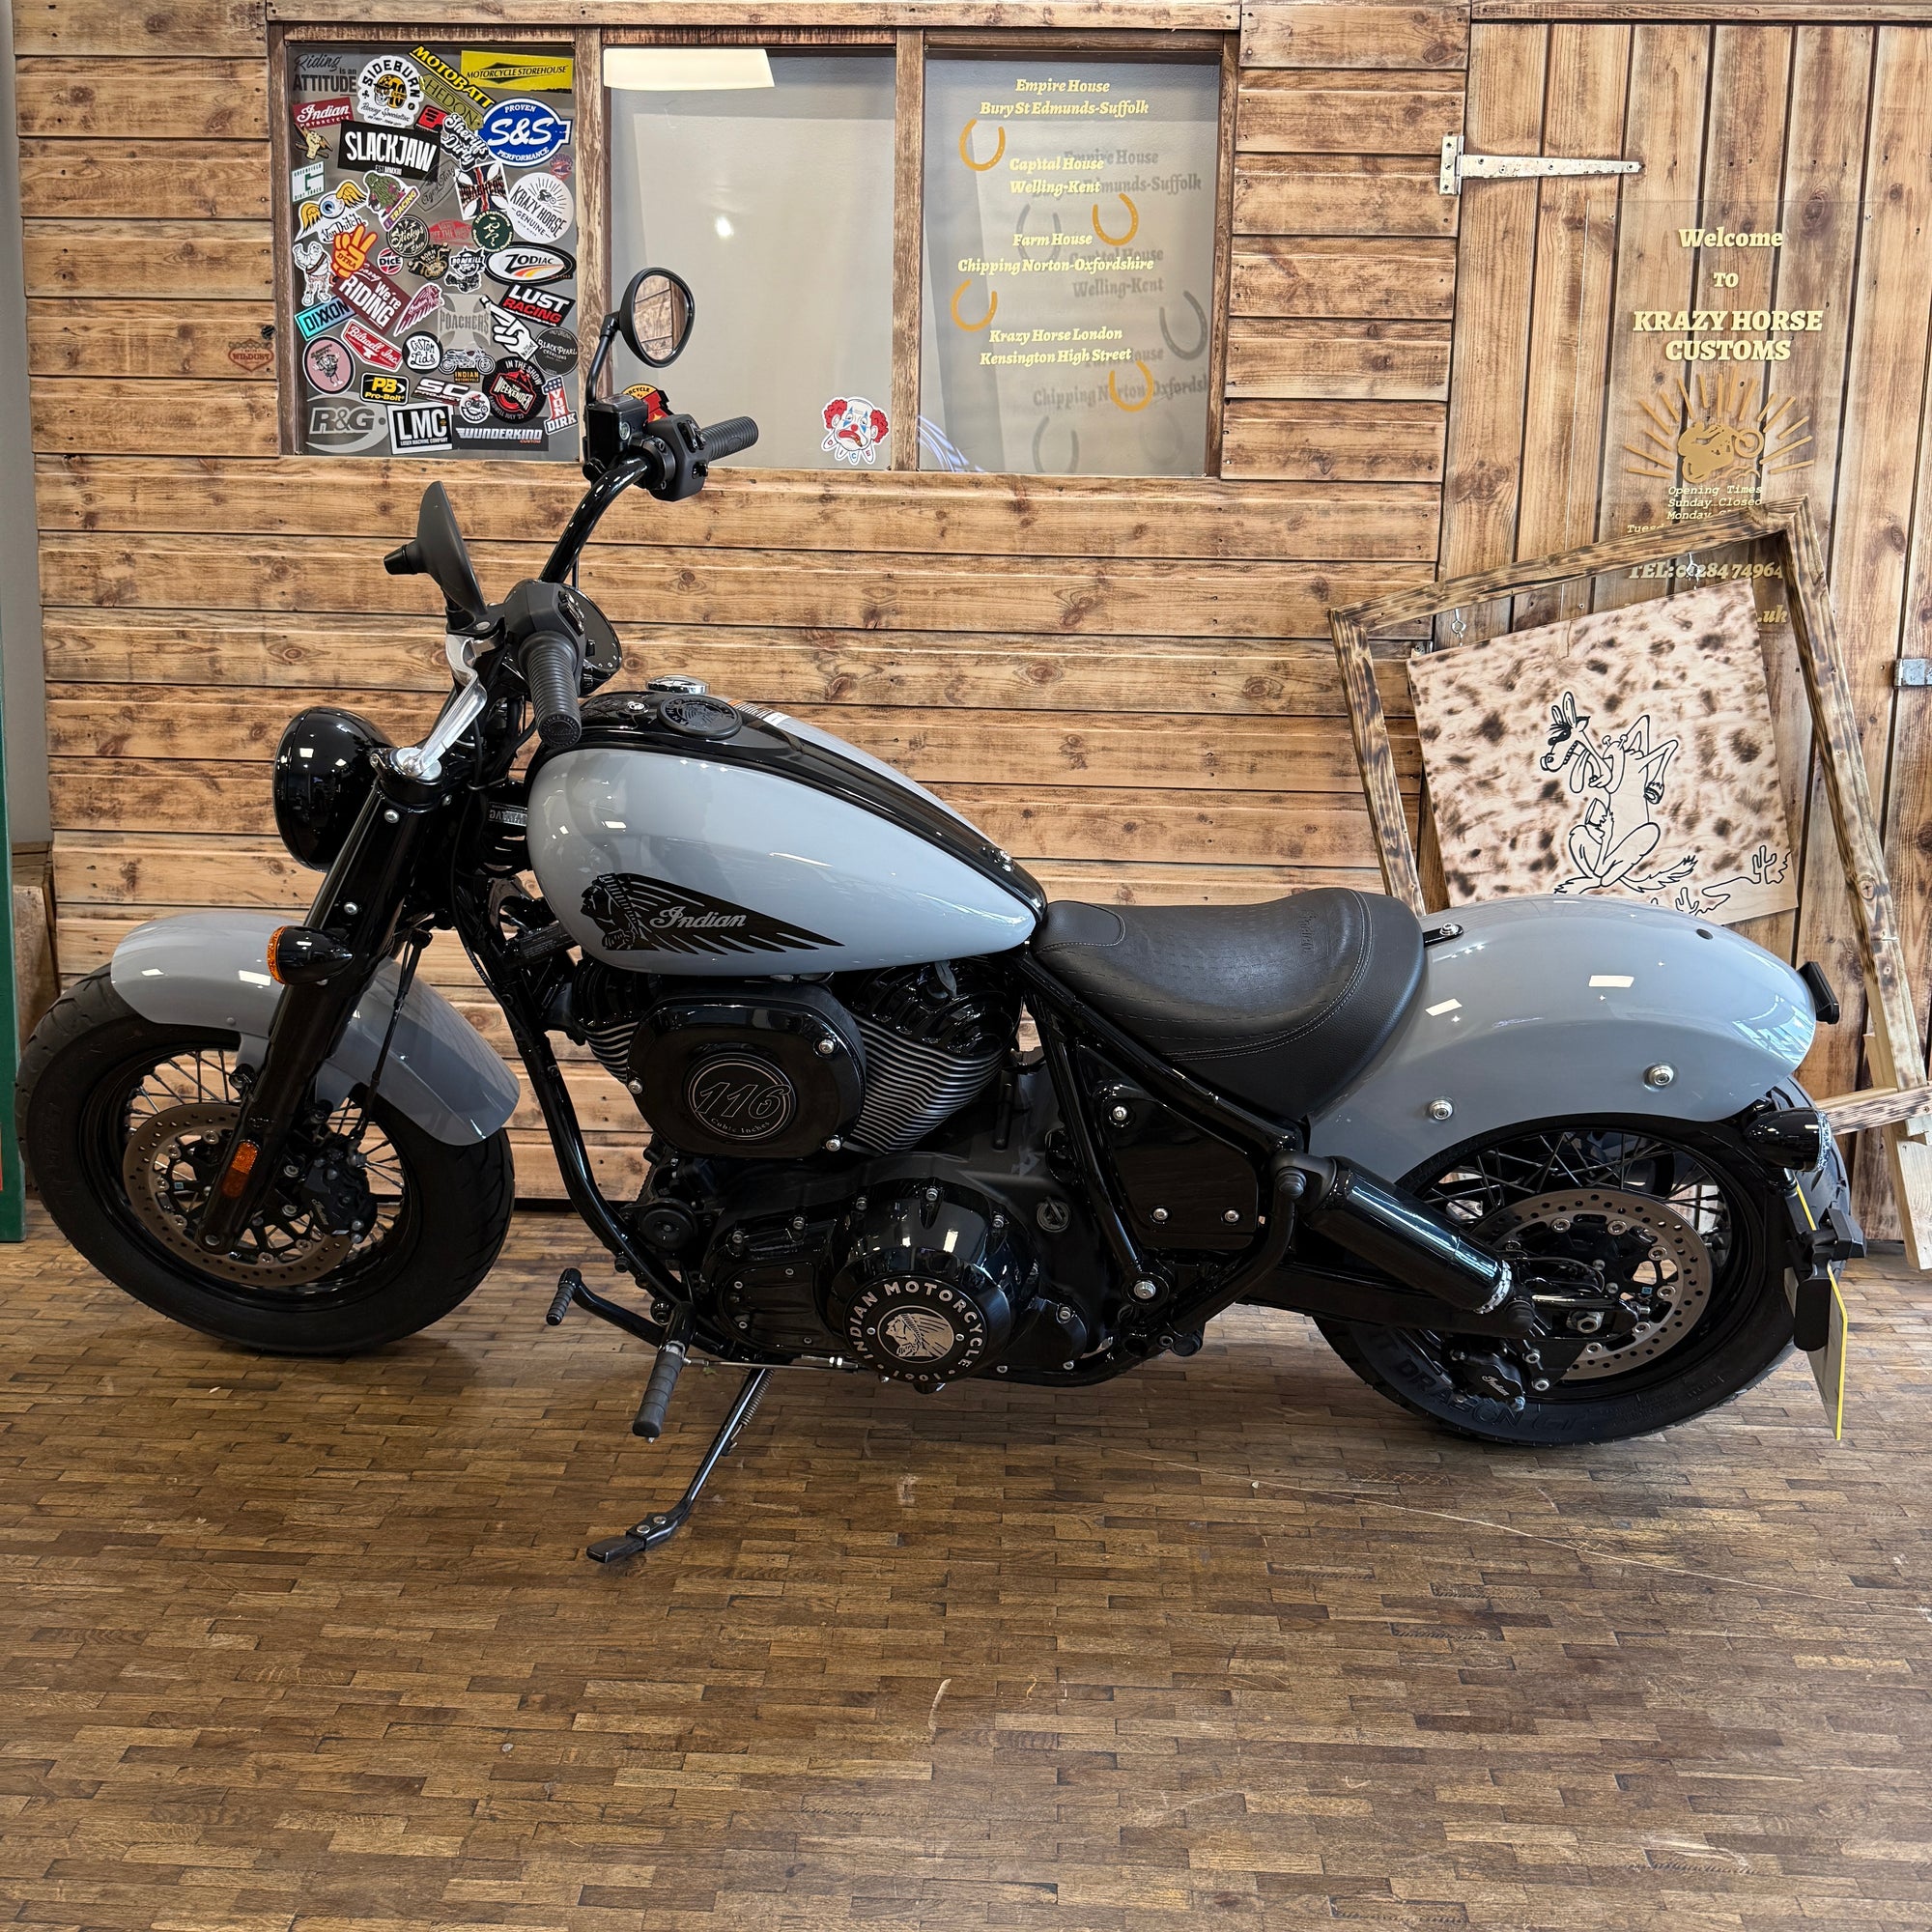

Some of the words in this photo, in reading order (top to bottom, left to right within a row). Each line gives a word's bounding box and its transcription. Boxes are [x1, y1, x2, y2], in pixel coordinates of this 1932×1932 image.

[294, 53, 342, 72] Riding
[467, 69, 515, 78] MOTORCYCLE
[517, 65, 567, 75] STOREHOUSE
[293, 74, 356, 92] ATTITUDE
[361, 59, 420, 98] SIDEBURN
[412, 46, 495, 108] MOTOBATT
[1015, 78, 1066, 95] Empire
[1067, 79, 1110, 93] House
[425, 79, 478, 127] HEDON
[504, 103, 536, 113] PROVEN
[980, 101, 1015, 118] Bury
[1015, 101, 1031, 114] St
[1032, 100, 1149, 117] Edmunds-Suffolk
[297, 104, 350, 123] Indian
[487, 118, 554, 146] S&S
[344, 131, 438, 172] SLACKJAW
[497, 146, 550, 161] PERFORMANCE
[1009, 157, 1061, 174] Capital
[1063, 157, 1104, 171] House
[1009, 180, 1101, 197] Welling-Kent
[510, 185, 540, 215] KRAZY
[537, 208, 567, 238] HORSE
[516, 211, 545, 236] GENUINE
[1012, 235, 1050, 246] Farm
[1051, 233, 1093, 245] House
[1678, 226, 1783, 247] Welcome
[379, 257, 402, 266] DiCE
[504, 254, 554, 273] ZODIAC
[957, 258, 1021, 275] Chipping
[1021, 256, 1154, 275] Norton-Oxfordshire
[1713, 271, 1739, 288] TO
[339, 274, 395, 327] RIDING
[508, 285, 570, 312] LUST
[303, 299, 351, 332] DIXXON
[502, 298, 562, 324] RACING
[1633, 310, 1728, 331] KRAZY
[1730, 310, 1824, 331] HORSE
[440, 310, 490, 334] POACHERS
[348, 326, 384, 353] Biltwell
[989, 329, 1031, 345] Krazy
[1032, 327, 1071, 342] Horse
[1072, 327, 1122, 341] London
[538, 339, 557, 353] BLACK
[557, 346, 578, 355] PEARL
[1665, 340, 1791, 361] CUSTOMS
[411, 352, 436, 366] Lids
[980, 351, 1056, 367] Kensington
[1057, 349, 1090, 367] High
[1091, 348, 1132, 361] Street
[505, 360, 513, 369] IN
[515, 360, 527, 370] THE
[526, 366, 543, 385] SHOW
[372, 377, 398, 393] PB
[417, 378, 469, 394] SC
[494, 376, 533, 411] WEEKENDER
[364, 391, 402, 402] Pro-Bolt
[549, 389, 566, 417] VON
[310, 408, 375, 434] R&G
[397, 410, 447, 440] LMC
[547, 413, 577, 433] DIRK
[455, 427, 543, 440] WUNDERKIND
[1668, 486, 1719, 496] Opening
[1727, 485, 1763, 494] Times
[649, 906, 747, 930] Indian
[693, 1082, 791, 1120] 116
[711, 1117, 737, 1133] Cubic
[741, 1122, 770, 1134] Inches
[849, 1291, 879, 1360] INDIAN
[884, 1280, 983, 1368] MOTORCYCLE
[893, 1370, 942, 1381] 1901
[1481, 1375, 1510, 1397] Indian
